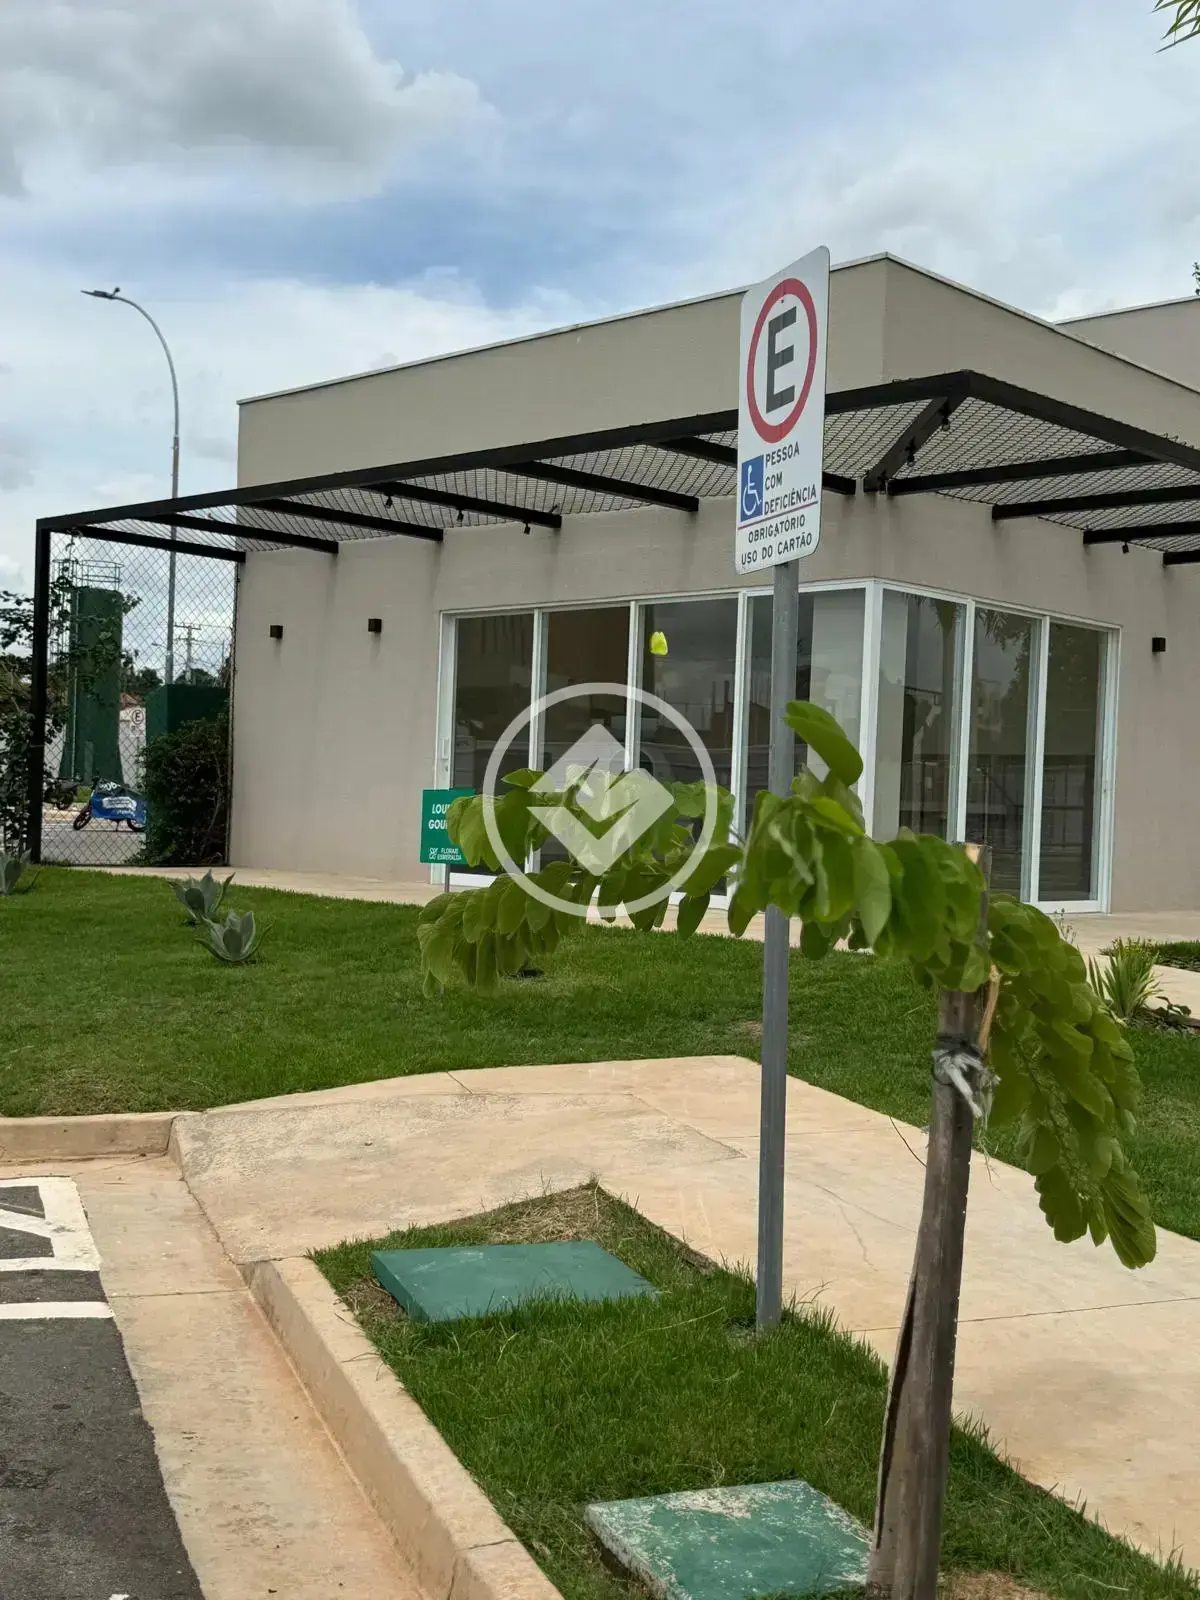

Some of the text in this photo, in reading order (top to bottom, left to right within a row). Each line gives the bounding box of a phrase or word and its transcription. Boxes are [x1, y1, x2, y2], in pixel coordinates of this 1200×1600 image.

[766, 306, 797, 414] E
[765, 441, 800, 467] PESSOA
[765, 472, 783, 490] COM
[764, 484, 817, 515] DEFICIÊNCIA
[748, 514, 806, 543] OBRIGATÓRIO
[741, 532, 812, 565] USO DO CARTÃO
[432, 803, 450, 815] LOU
